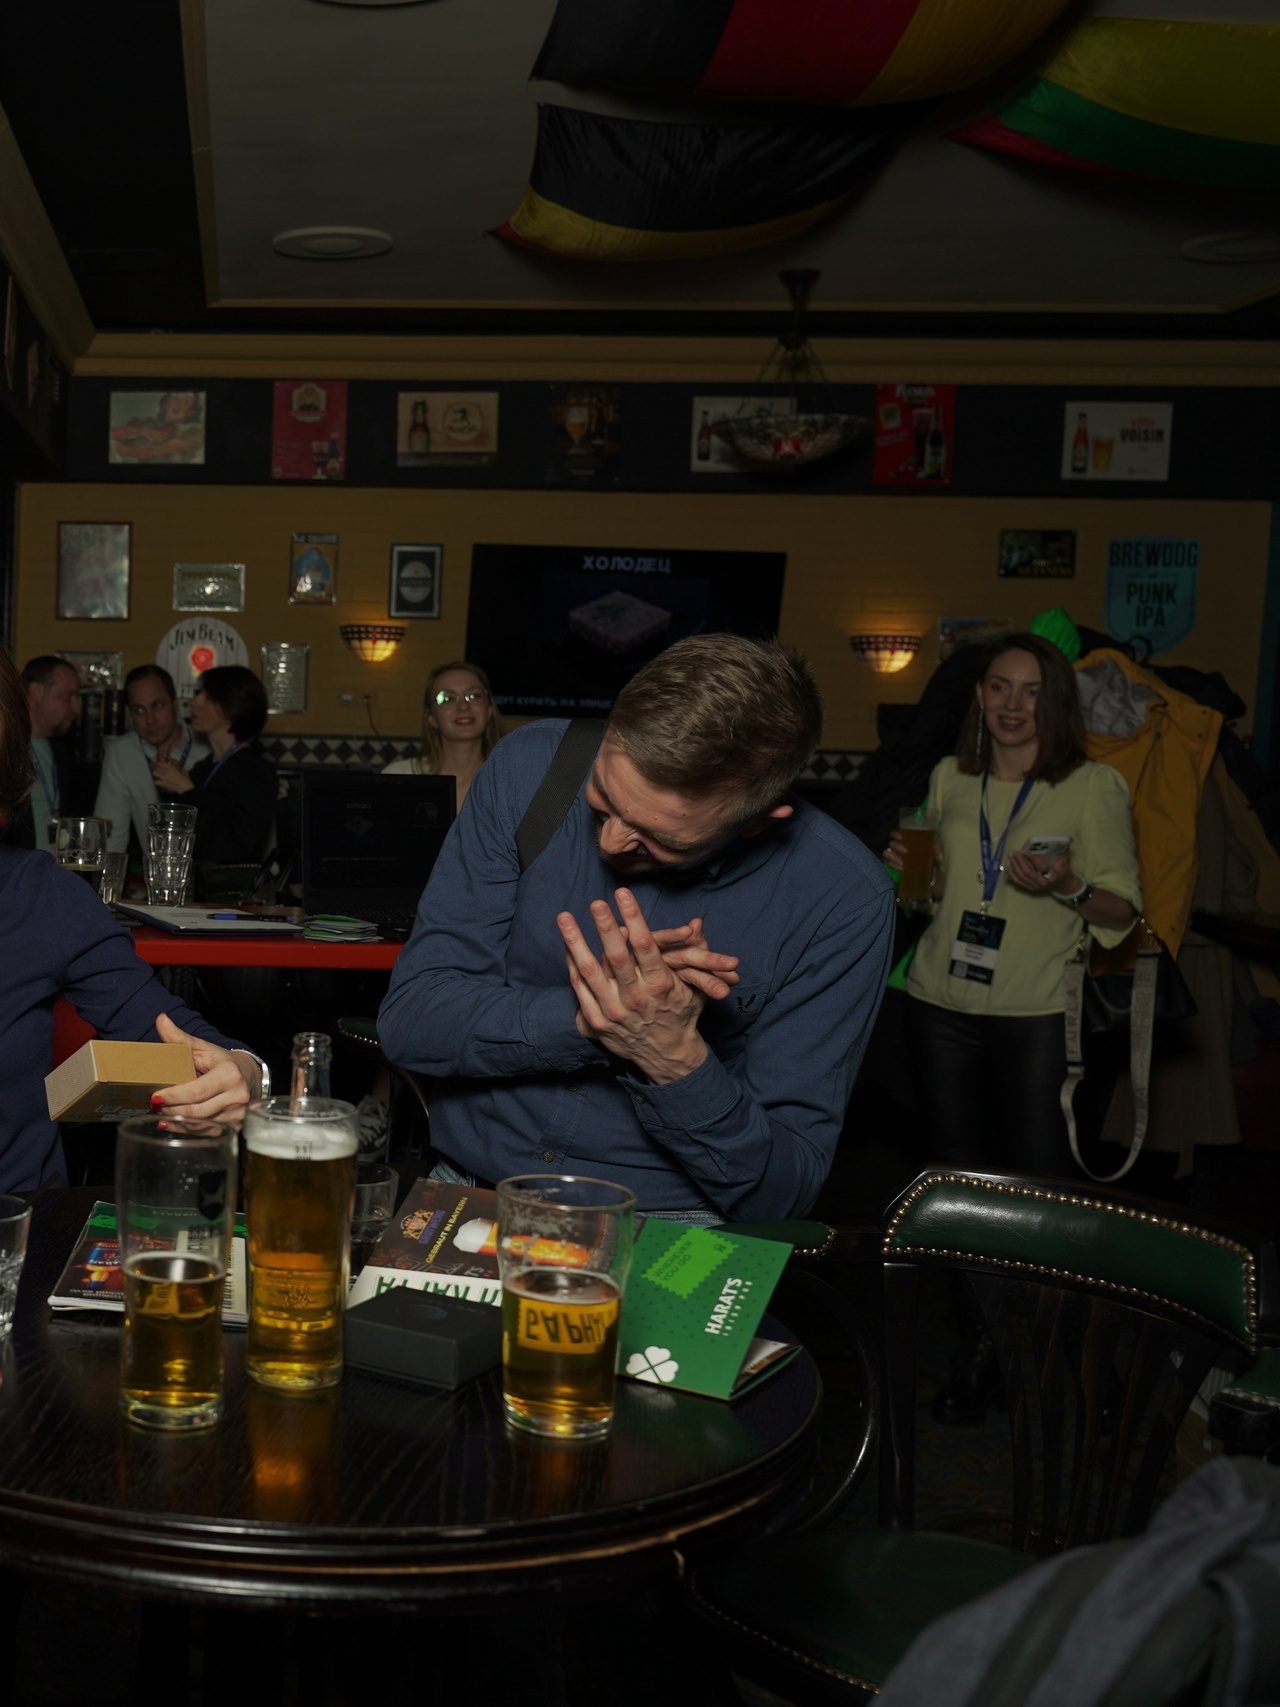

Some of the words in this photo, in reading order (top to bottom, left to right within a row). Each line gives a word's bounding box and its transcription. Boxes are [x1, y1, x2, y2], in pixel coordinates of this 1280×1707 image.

[1120, 428, 1164, 442] VOISIN
[581, 554, 671, 574] ХОЛОДЕЦ
[1110, 541, 1199, 568] BREWDOG
[1127, 583, 1177, 605] PUNK
[1136, 606, 1166, 627] IPA
[170, 628, 195, 650] JIM
[199, 623, 235, 651] BEAM
[516, 695, 558, 707] КУРИТЬ
[560, 697, 576, 708] НА
[447, 1195, 469, 1225] BAYERN
[443, 1222, 453, 1232] IN
[425, 1229, 449, 1265] GEBRAUT
[655, 1240, 692, 1277] WHEREVER
[663, 1263, 681, 1281] YOU
[677, 1254, 691, 1267] GO
